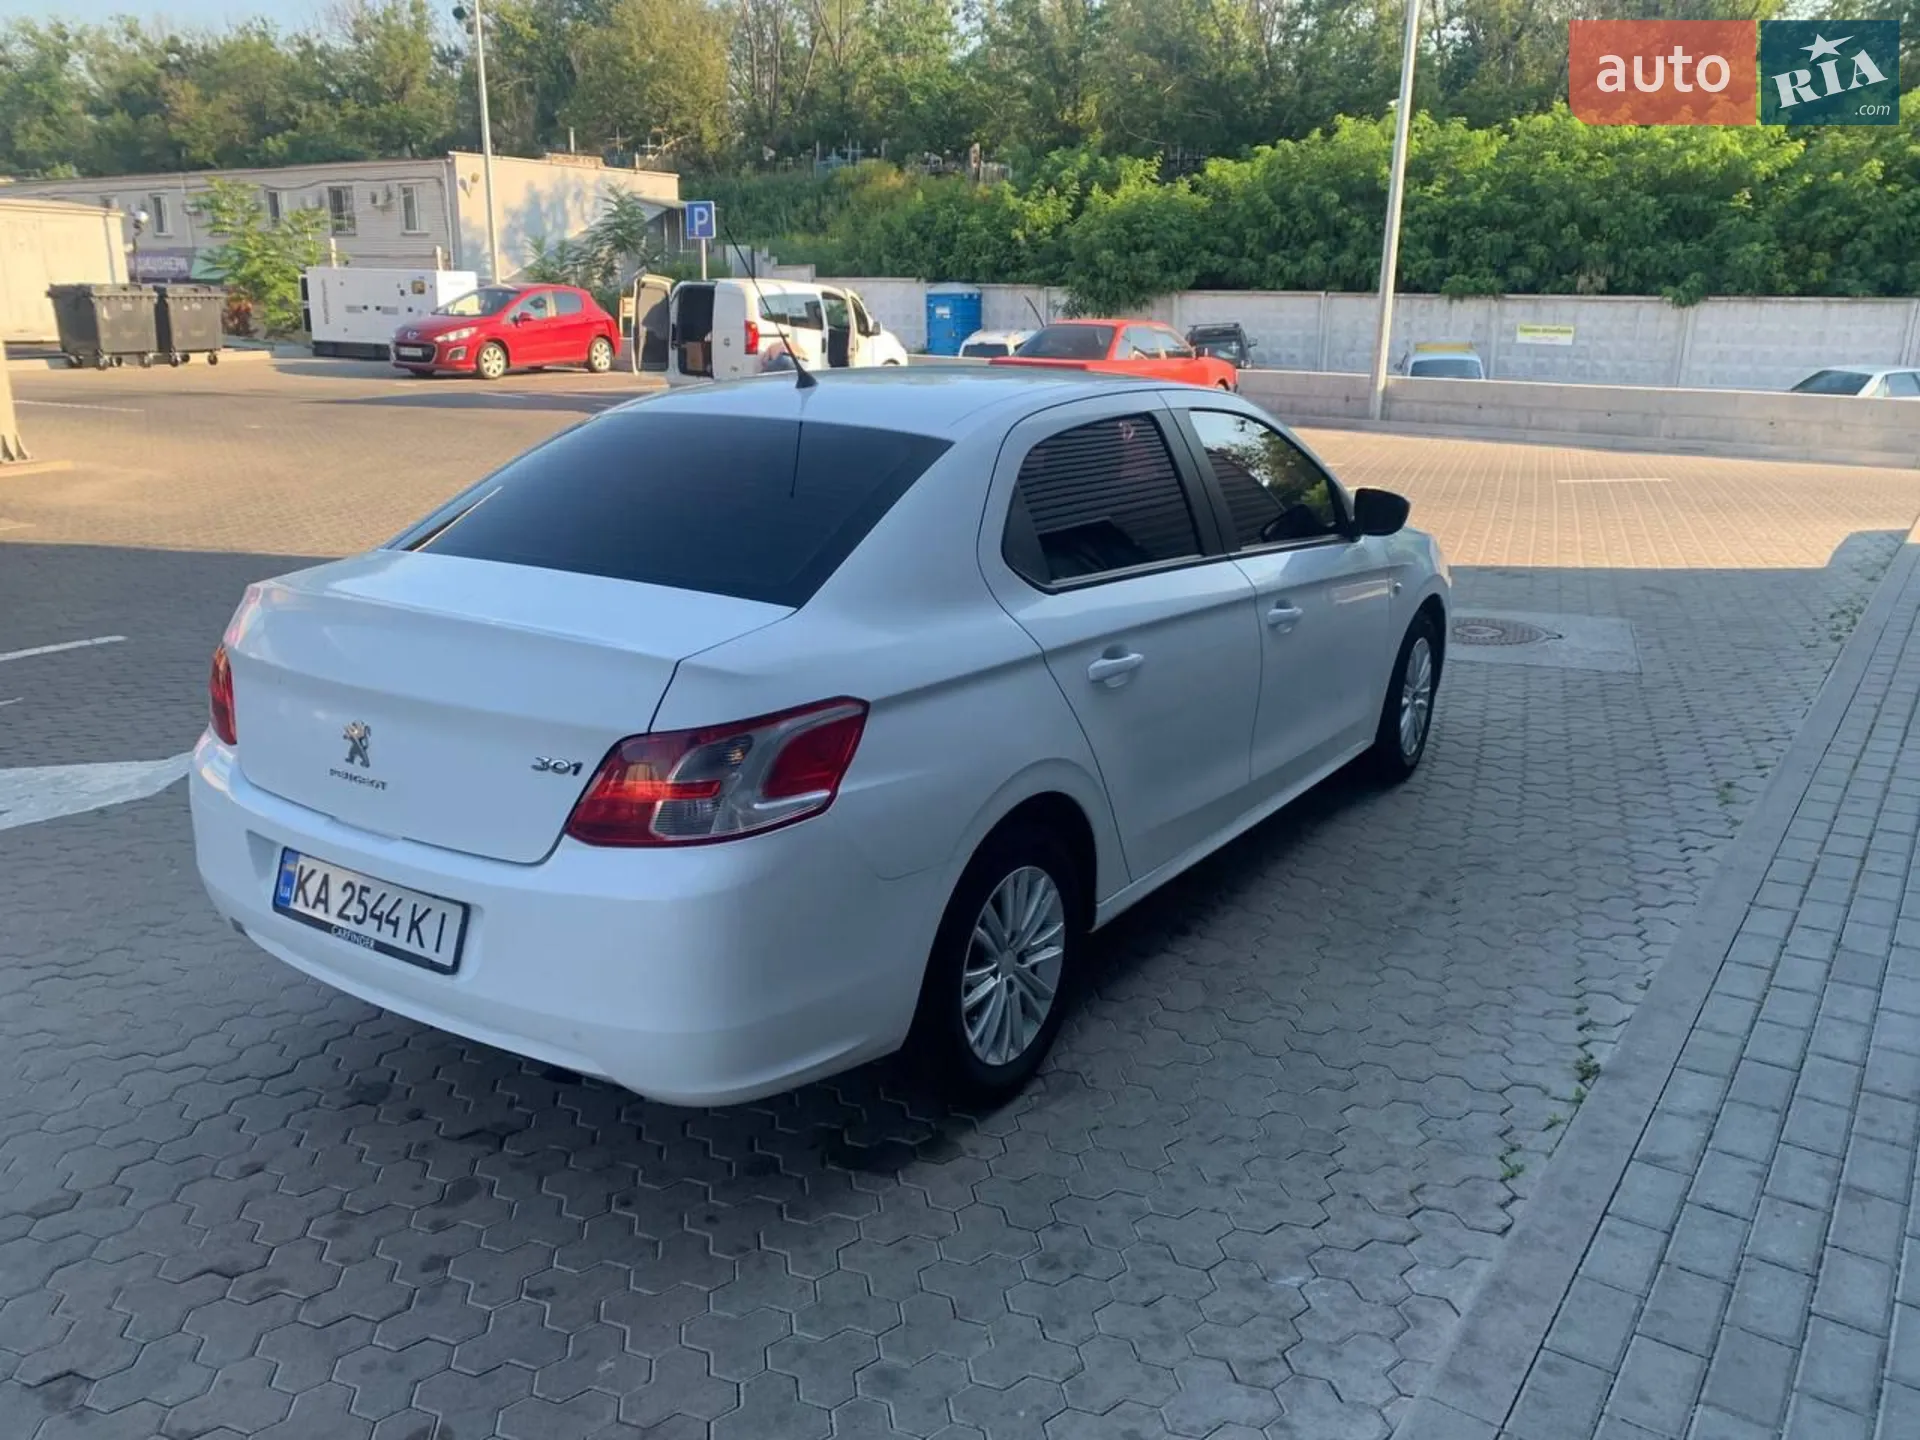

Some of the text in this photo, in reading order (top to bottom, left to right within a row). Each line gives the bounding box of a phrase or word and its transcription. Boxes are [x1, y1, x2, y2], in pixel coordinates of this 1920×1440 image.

[694, 207, 709, 235] P
[530, 756, 584, 776] 301
[293, 864, 446, 954] KA 2544 KI
